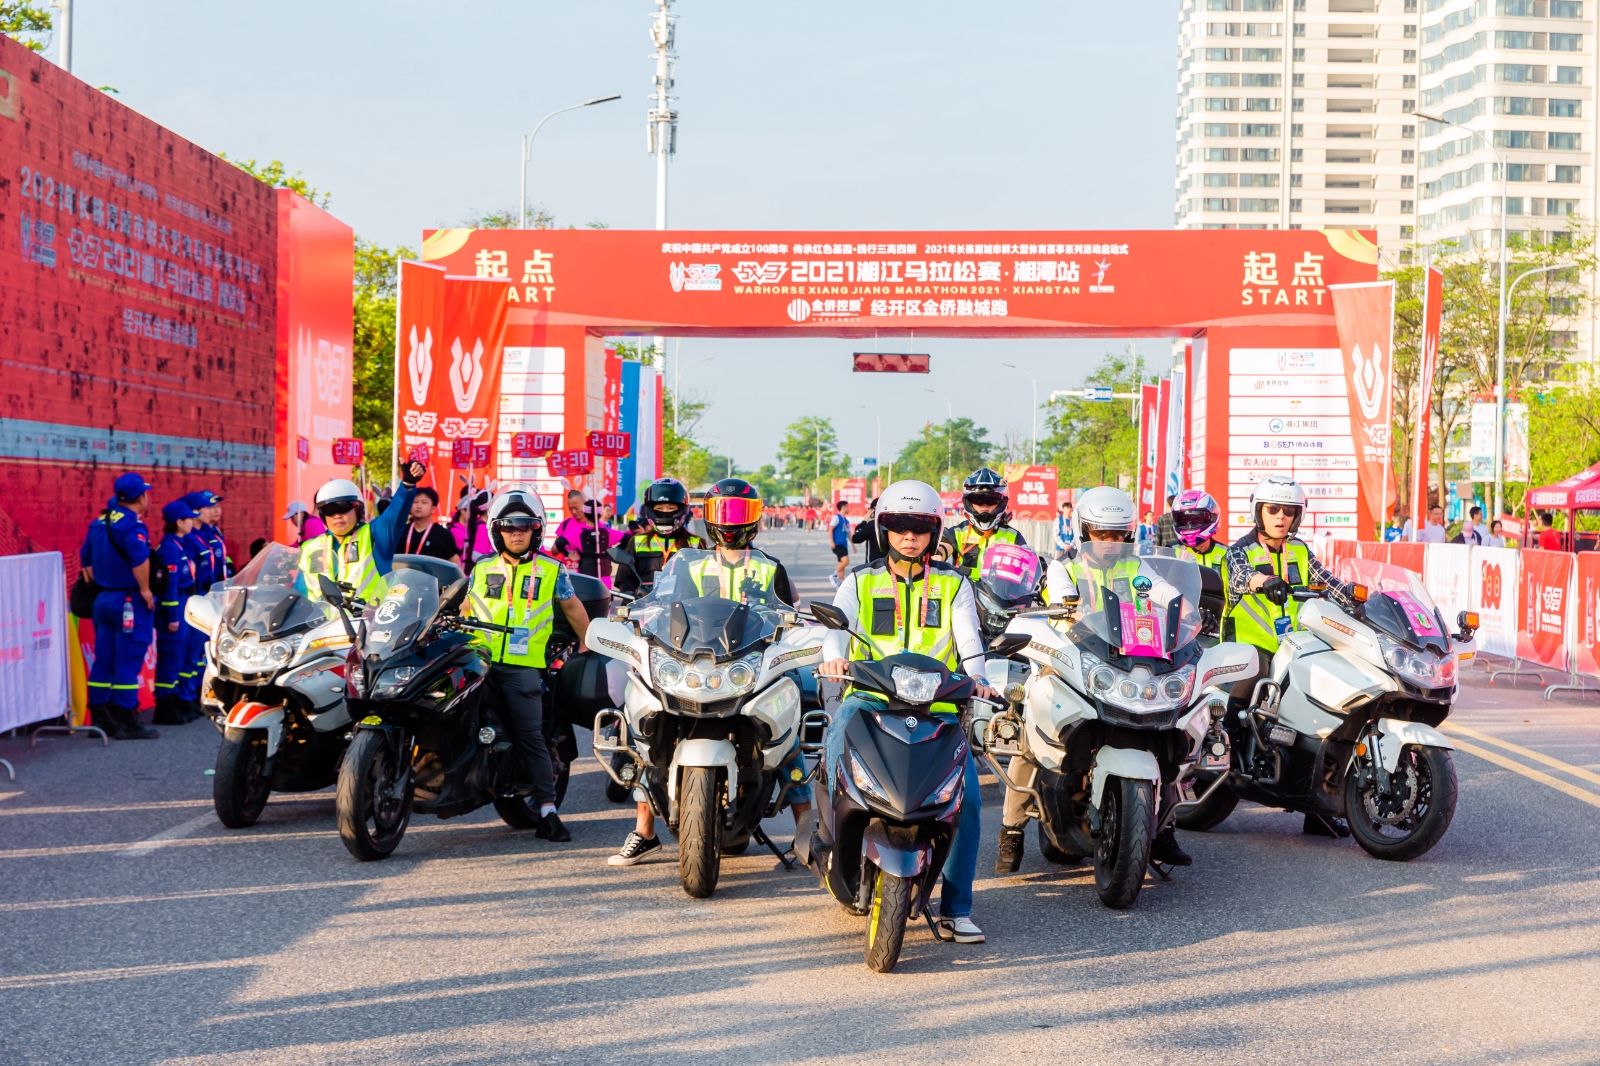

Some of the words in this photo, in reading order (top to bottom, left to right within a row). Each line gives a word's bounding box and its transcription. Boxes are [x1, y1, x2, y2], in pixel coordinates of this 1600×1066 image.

[1243, 251, 1325, 286] 起点
[507, 286, 556, 303] ART
[733, 286, 806, 295] WARHORSE
[808, 286, 849, 295] XIANG
[851, 286, 890, 295] JIANG
[895, 286, 968, 295] MARATHON
[970, 286, 1000, 295] 2021
[1012, 286, 1081, 295] XIANGTAN
[1241, 288, 1326, 305] START
[870, 298, 1008, 317] 经开区金侨融城跑
[335, 440, 360, 452] 2:30
[516, 434, 555, 450] 3:00
[591, 433, 625, 450] 2:00
[551, 451, 589, 469] 2:30
[1022, 481, 1045, 493] 半马
